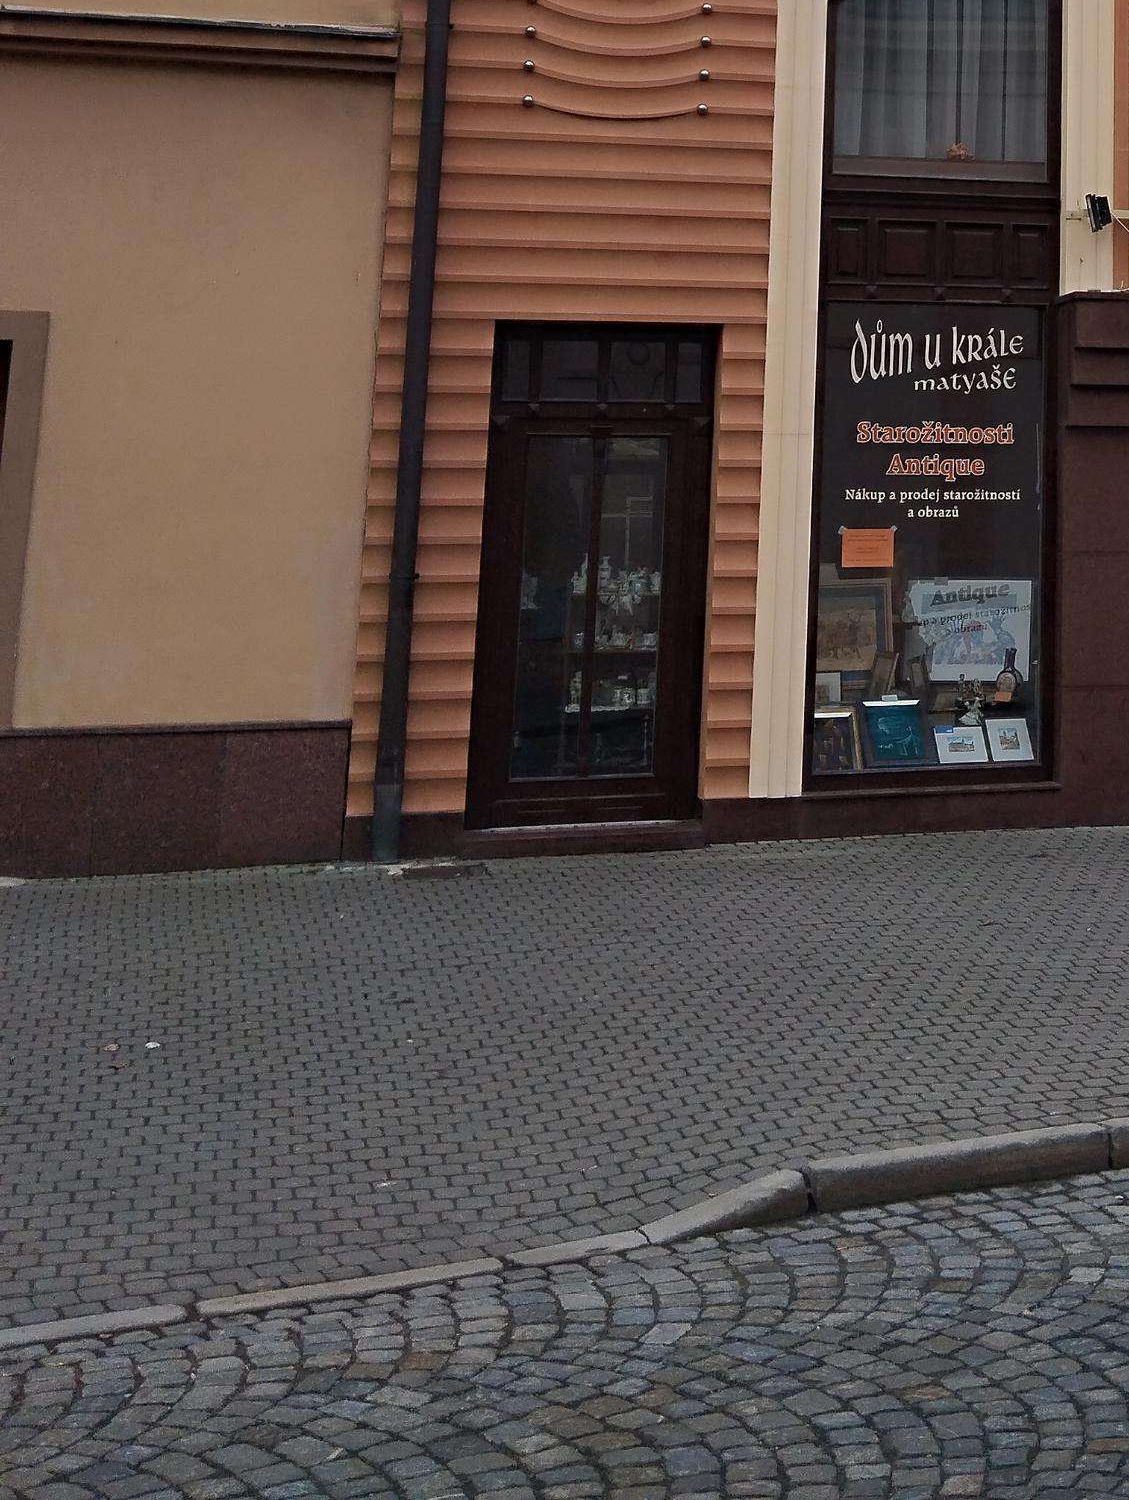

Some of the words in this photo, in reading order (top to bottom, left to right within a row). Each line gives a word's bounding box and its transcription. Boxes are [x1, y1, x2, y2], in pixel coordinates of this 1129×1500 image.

[924, 333, 942, 370] u
[856, 421, 1015, 445] Starožitnosti
[885, 453, 985, 482] Antique
[845, 488, 886, 503] Nákup
[889, 491, 897, 500] a
[900, 488, 940, 503] prodej
[943, 488, 1021, 501] starožitností
[907, 508, 914, 518] a
[917, 505, 959, 518] obrazů
